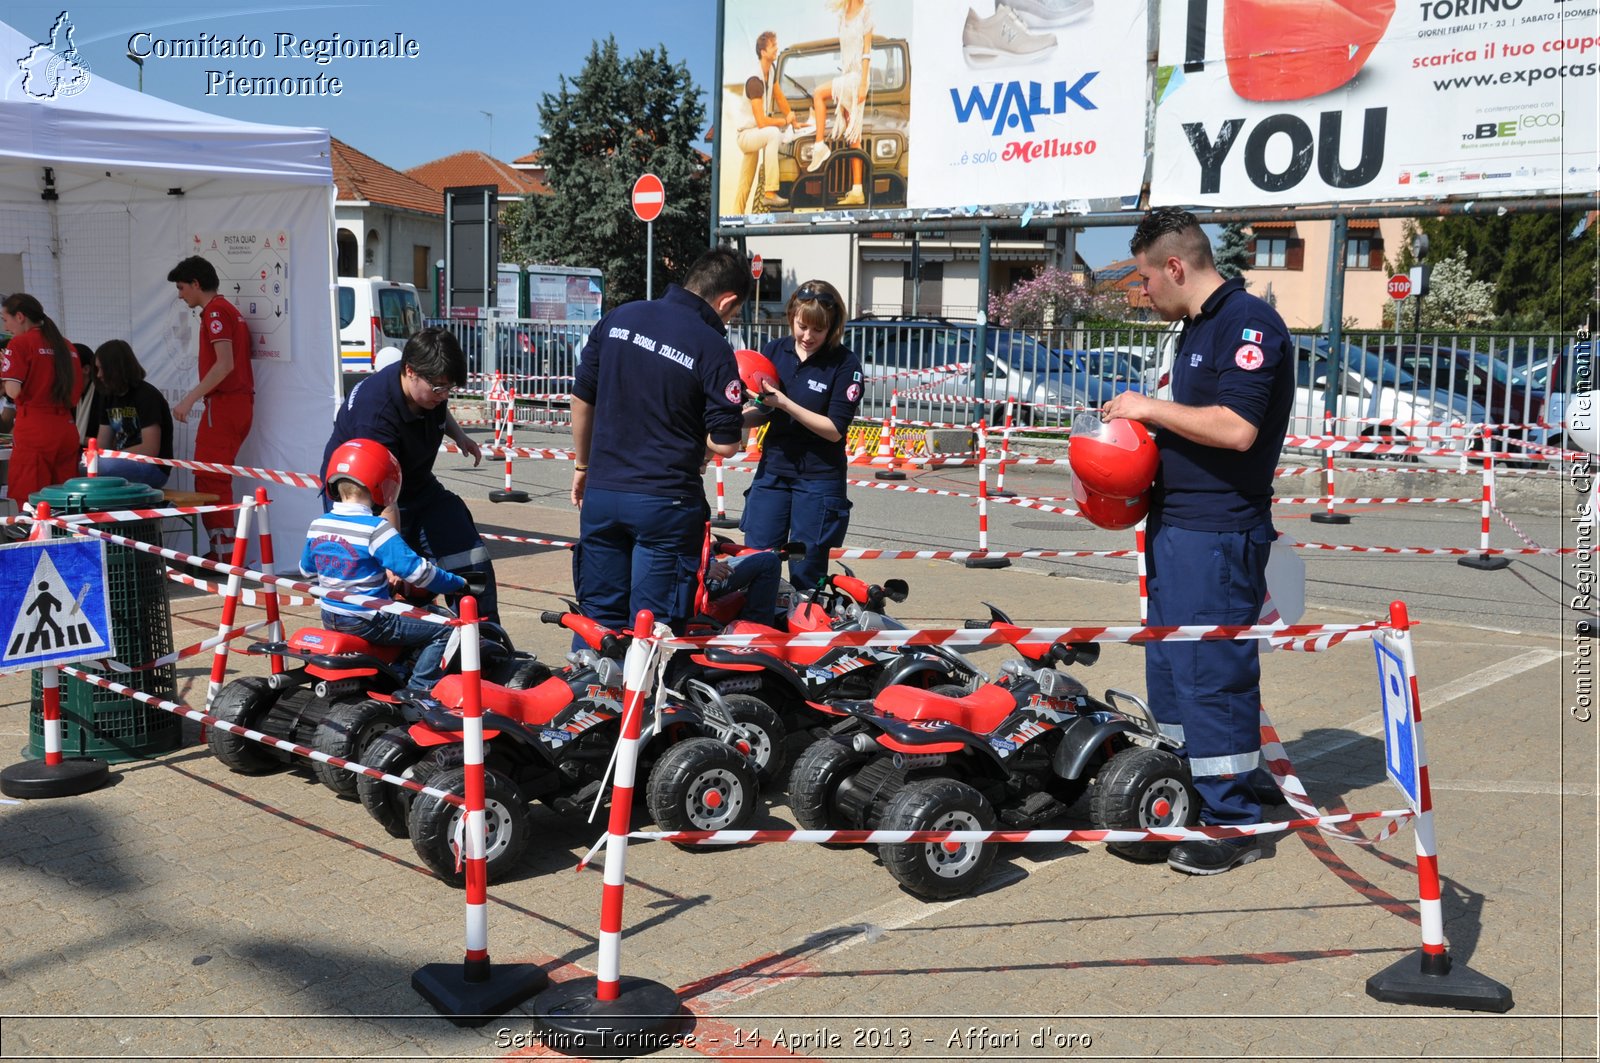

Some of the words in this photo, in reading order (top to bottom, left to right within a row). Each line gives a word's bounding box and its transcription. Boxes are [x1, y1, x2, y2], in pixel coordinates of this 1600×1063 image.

[1420, 0, 1523, 22] TORINO
[1417, 27, 1446, 38] GIORNI
[1448, 24, 1475, 34] FERIALI
[1478, 22, 1488, 30] 17
[1496, 19, 1507, 28] 23
[1521, 12, 1555, 24] SABATO
[1412, 49, 1477, 68] scarica
[1484, 42, 1496, 59] il
[1502, 42, 1535, 57] tuo
[1433, 62, 1600, 91] www.expocas
[950, 70, 1101, 136] WALK
[1484, 102, 1539, 115] contemporanea
[1540, 101, 1555, 109] con
[971, 148, 997, 165] solo
[1001, 138, 1097, 164] Melluso
[1181, 106, 1388, 194] YOU
[224, 235, 240, 245] PISTA
[240, 235, 257, 244] QUAD
[1388, 281, 1411, 293] STOP
[609, 327, 631, 341] CROCE
[632, 333, 657, 351] ROSSA
[658, 344, 695, 370] ITALIANA
[1378, 647, 1408, 774] P
